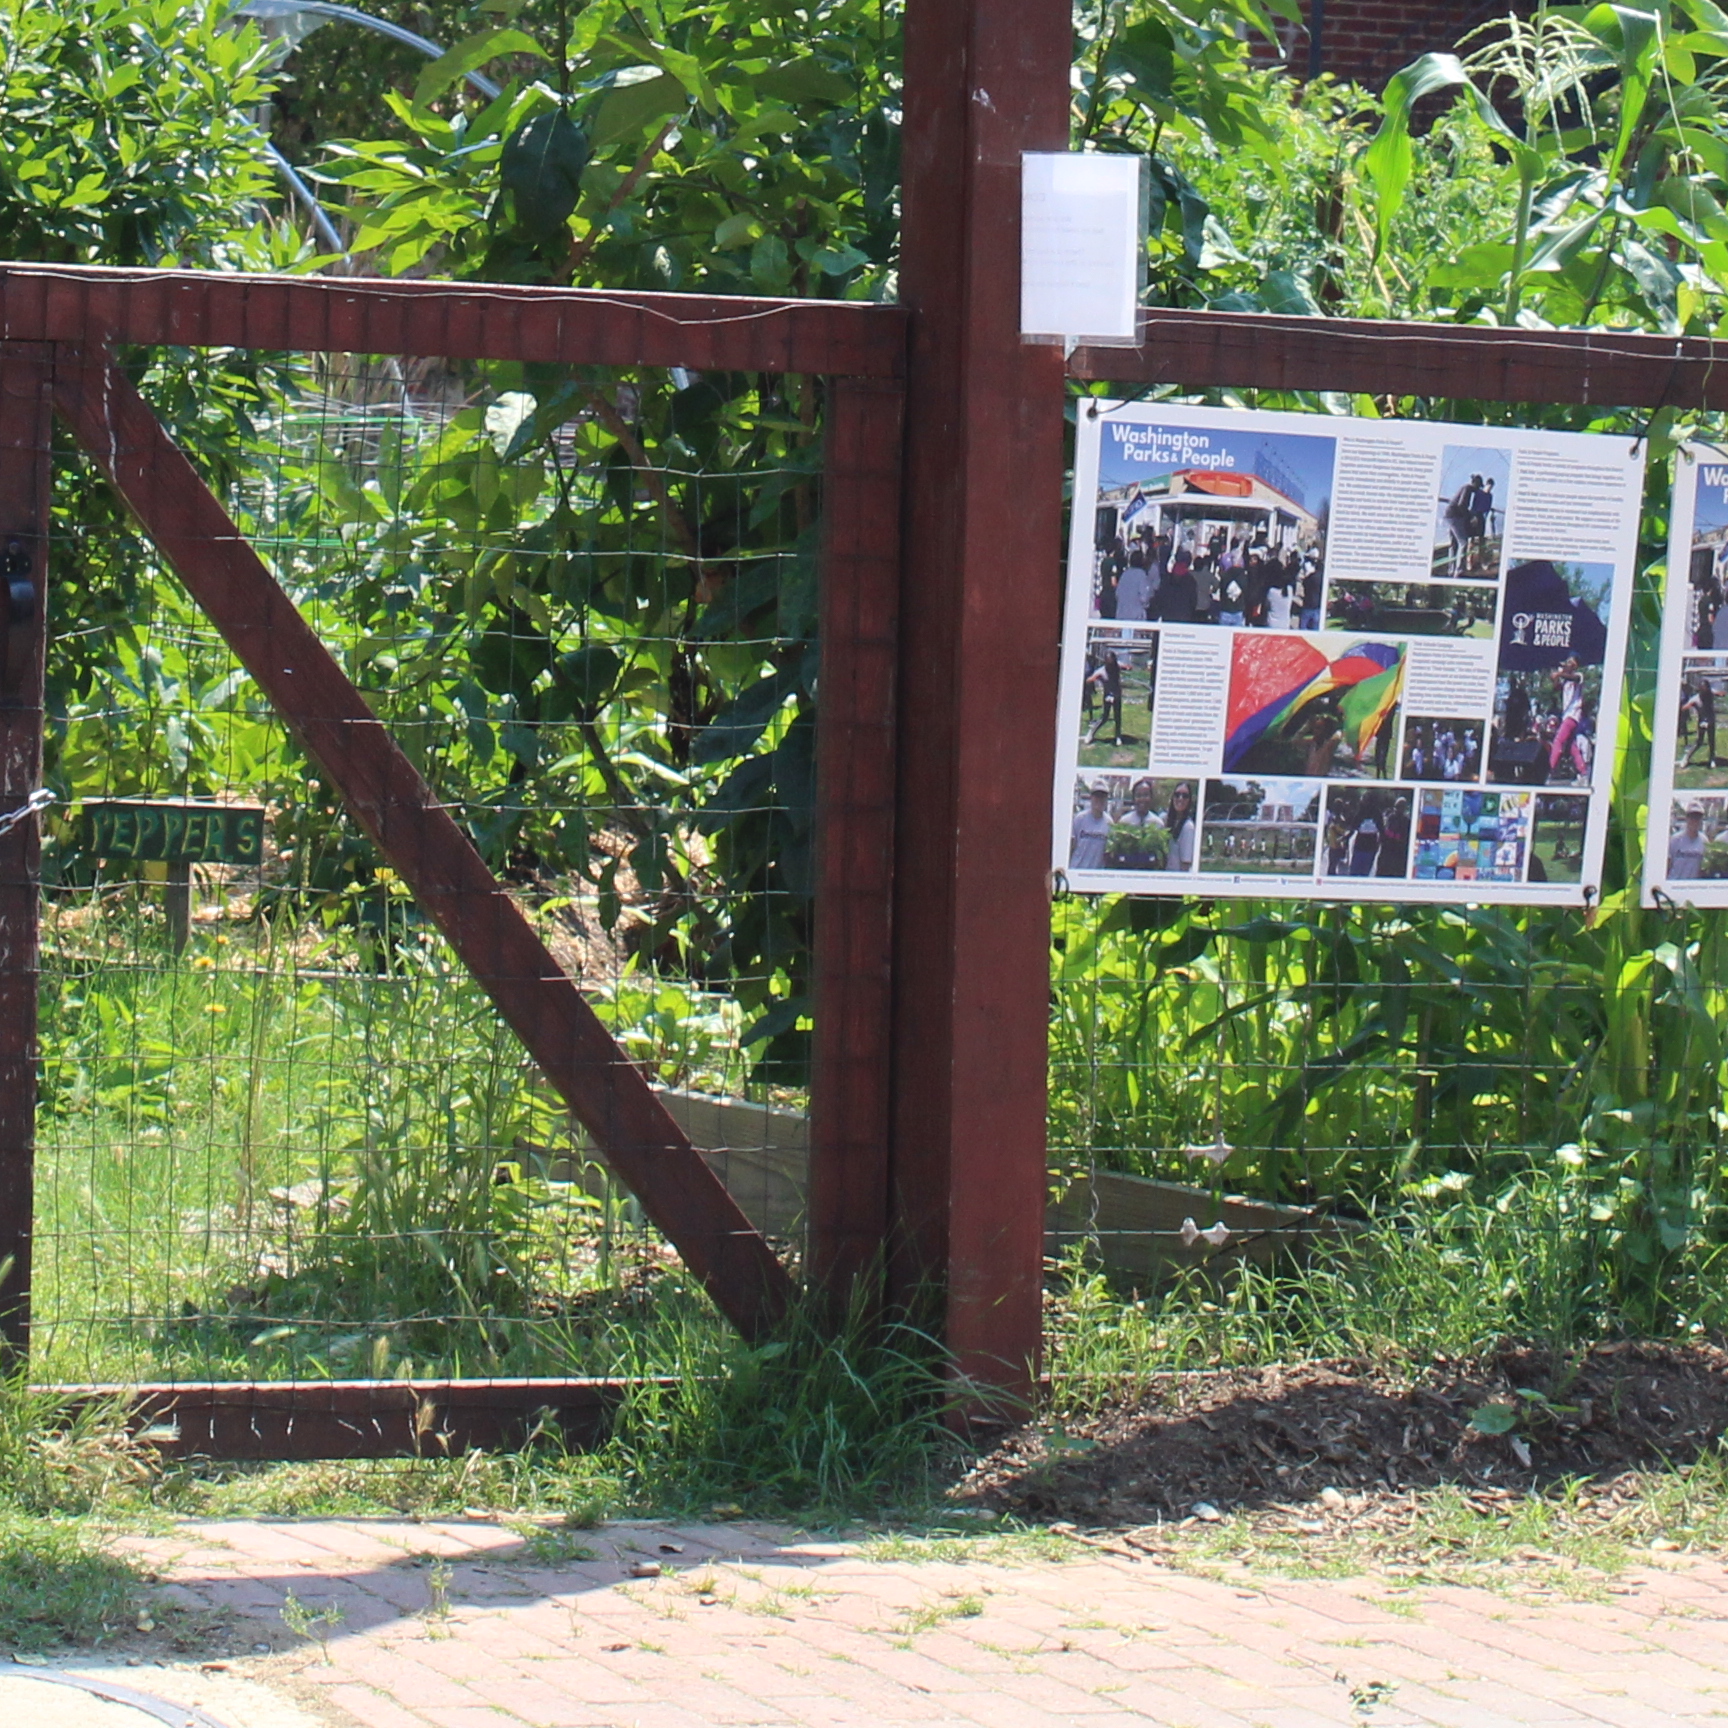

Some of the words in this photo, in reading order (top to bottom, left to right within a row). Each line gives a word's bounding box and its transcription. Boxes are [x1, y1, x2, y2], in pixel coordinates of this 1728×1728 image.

[1111, 423, 1210, 450] Washington
[1123, 443, 1170, 464] Parks
[1170, 452, 1178, 463] &
[1181, 445, 1235, 471] People
[1534, 619, 1572, 635] PARKS
